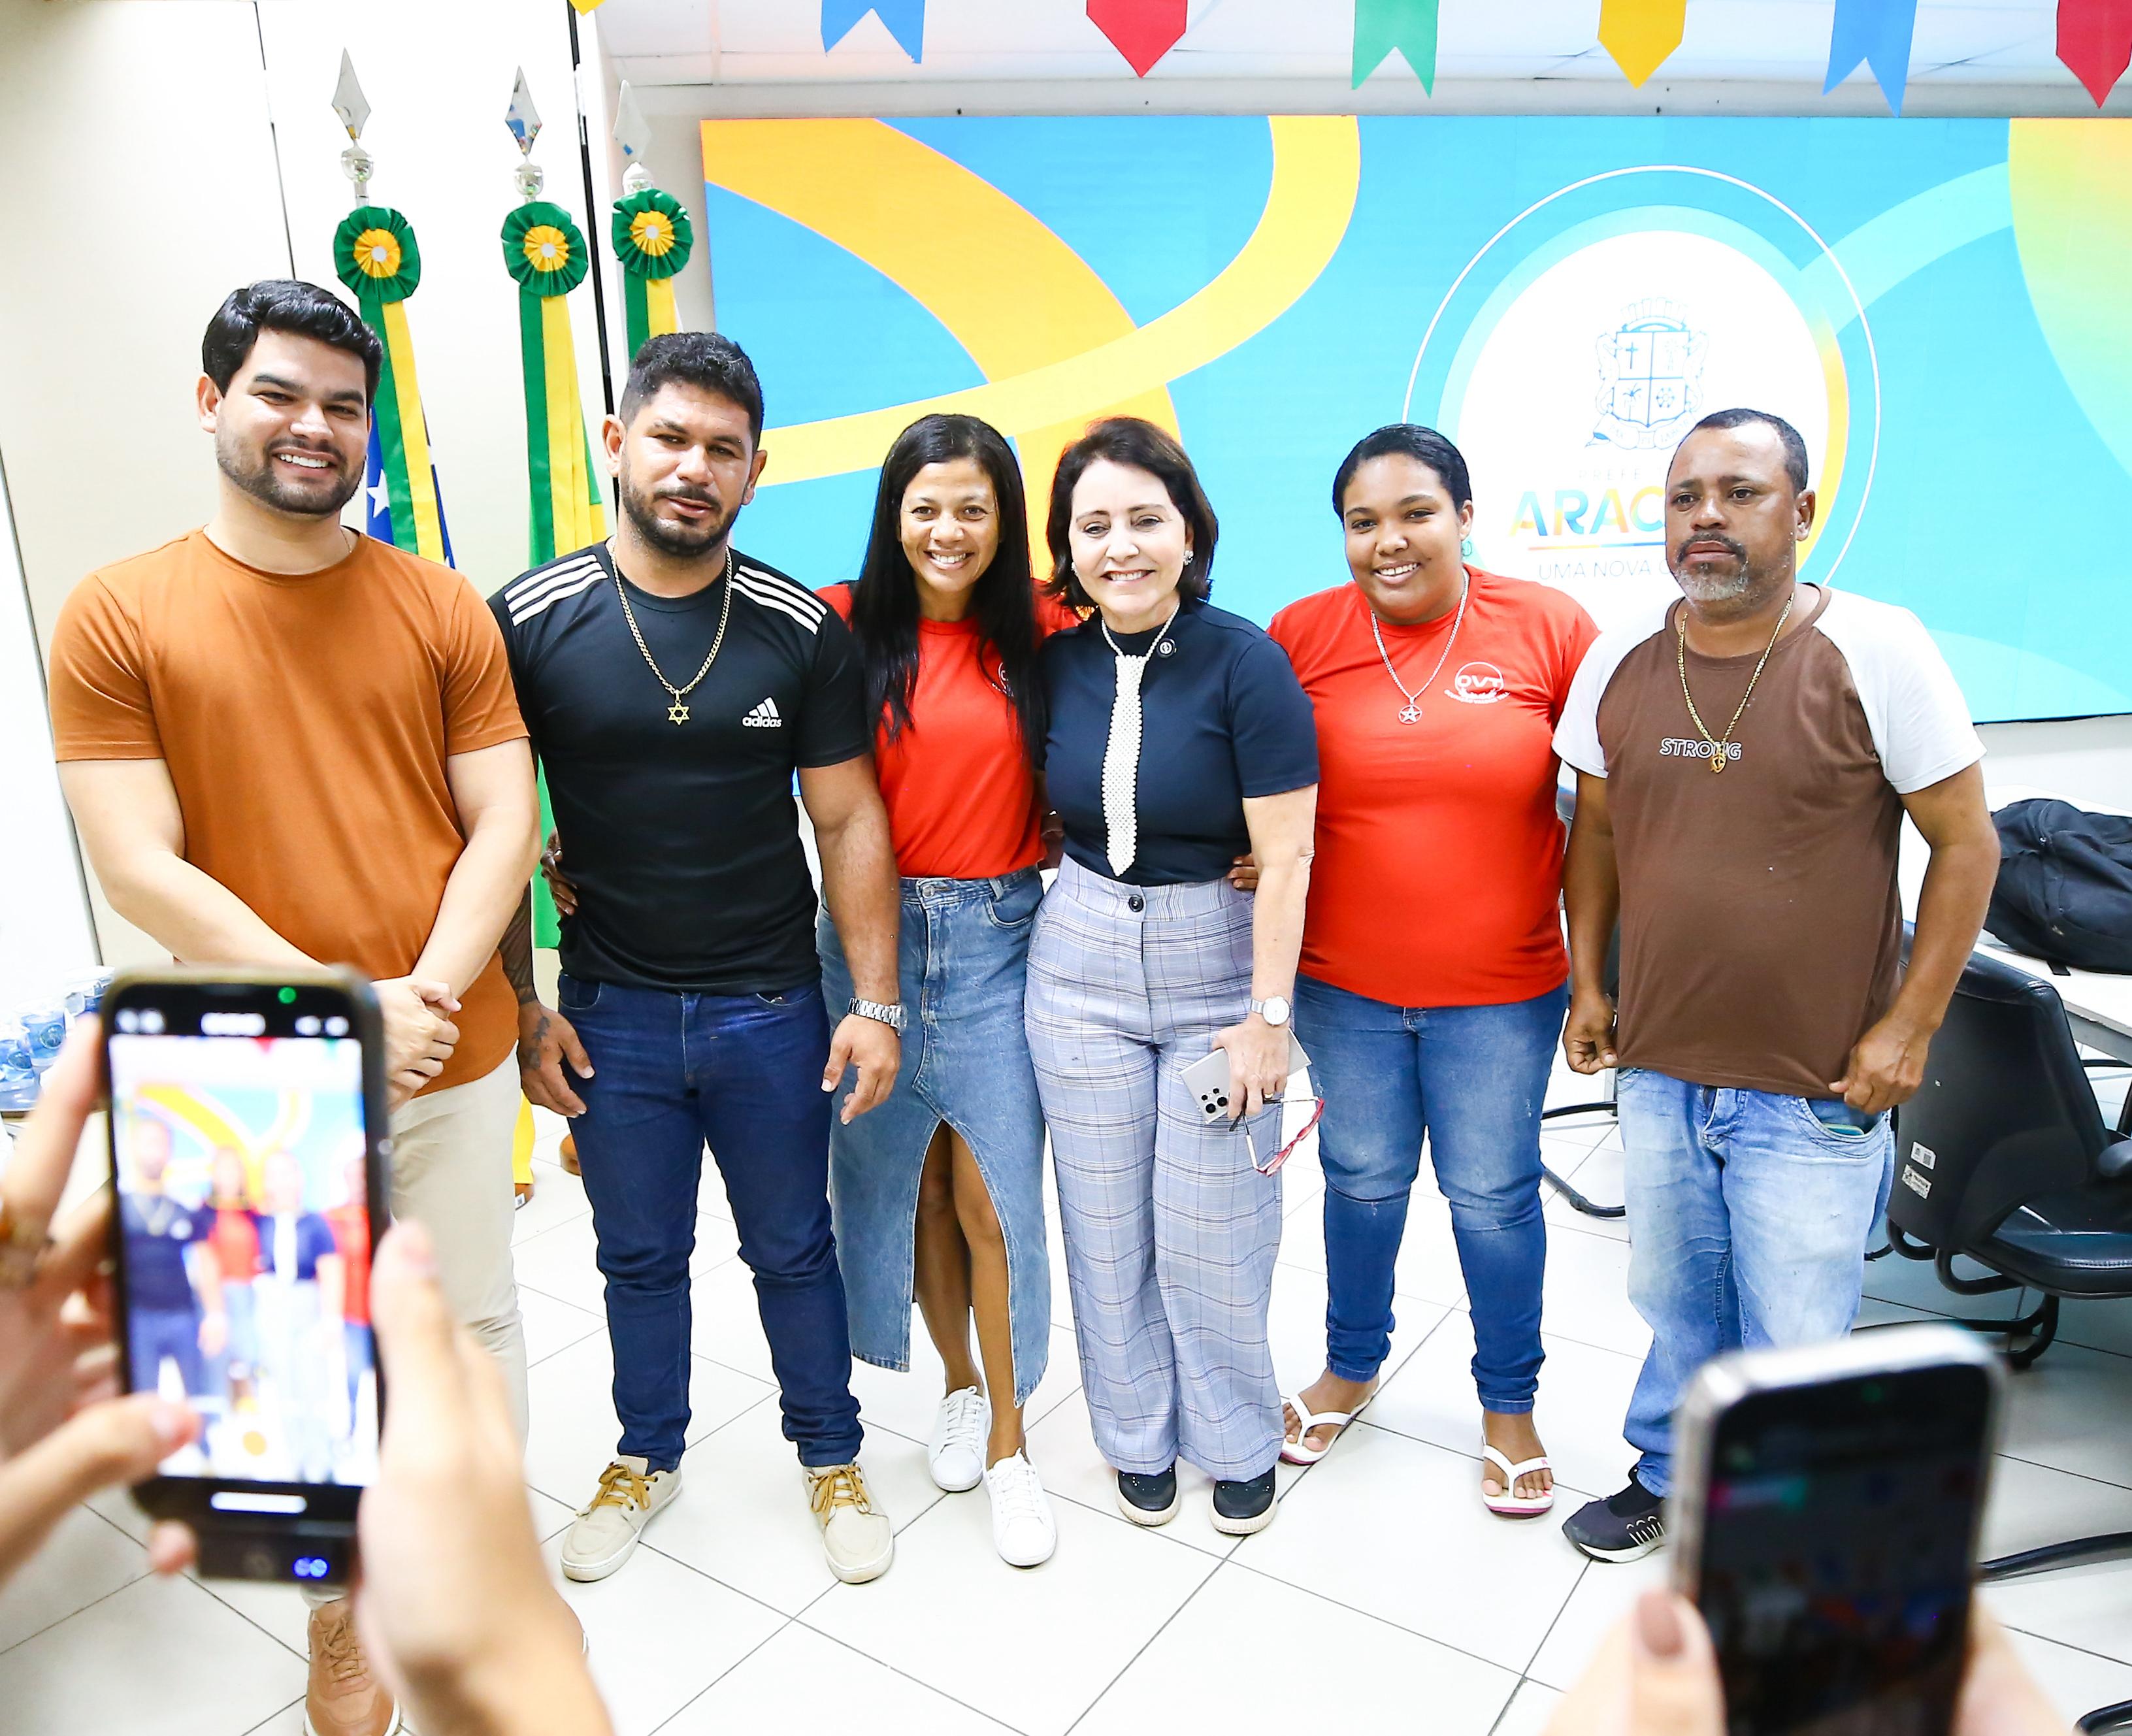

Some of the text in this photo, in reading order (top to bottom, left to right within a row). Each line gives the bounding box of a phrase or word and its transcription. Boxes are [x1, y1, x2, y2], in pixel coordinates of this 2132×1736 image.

[1578, 467, 1665, 481] PREFET
[1509, 485, 1665, 536] ARAC
[1539, 563, 1586, 580] UMA
[1594, 560, 1651, 578] NOVA
[1457, 674, 1501, 688] OVT
[742, 715, 782, 728] adidas
